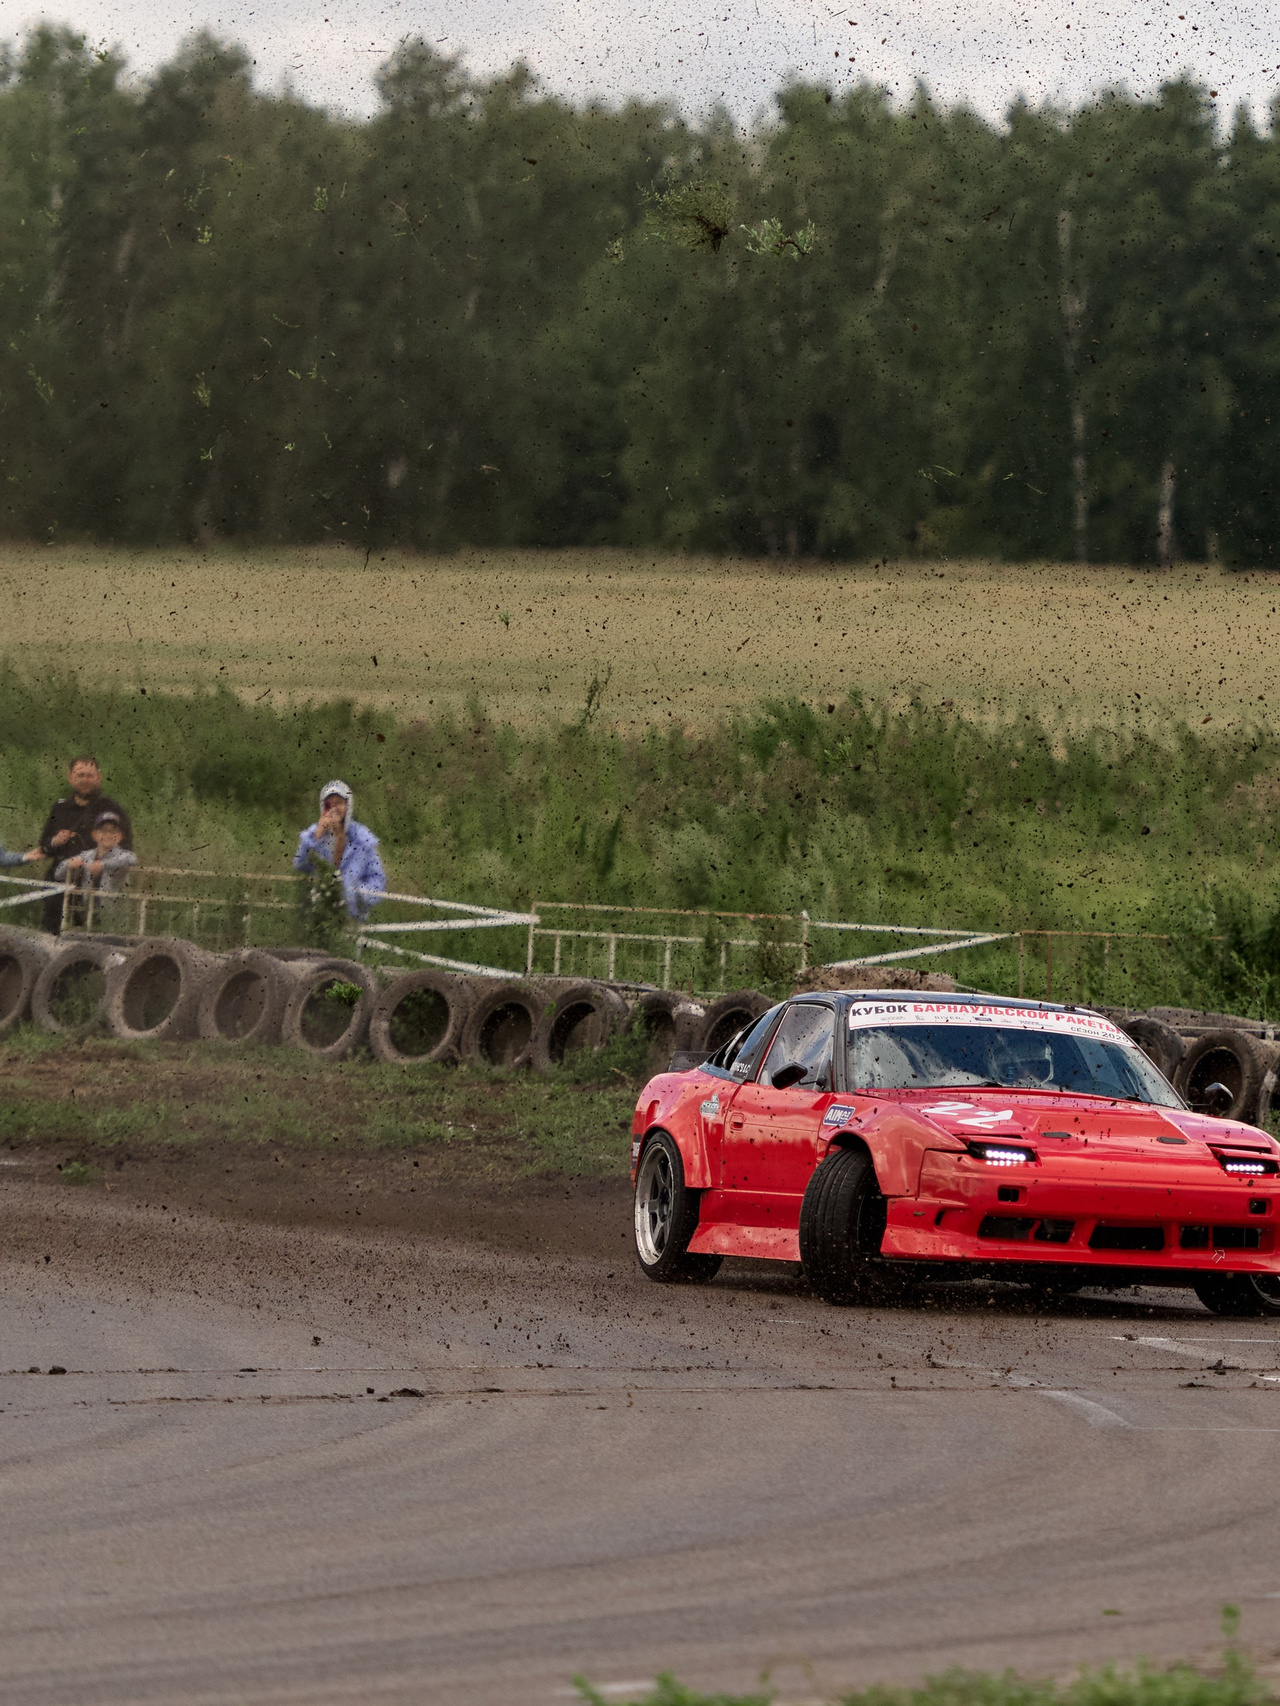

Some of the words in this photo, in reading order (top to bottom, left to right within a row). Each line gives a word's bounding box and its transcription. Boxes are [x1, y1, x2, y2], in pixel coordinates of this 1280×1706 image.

[852, 1004, 908, 1017] КУБОК
[913, 1004, 1049, 1021] БАРНАУЛЬСКОЙ
[1071, 1026, 1100, 1036] СЕЗОН
[1102, 1031, 1129, 1043] 2025
[920, 1101, 1013, 1129] 22
